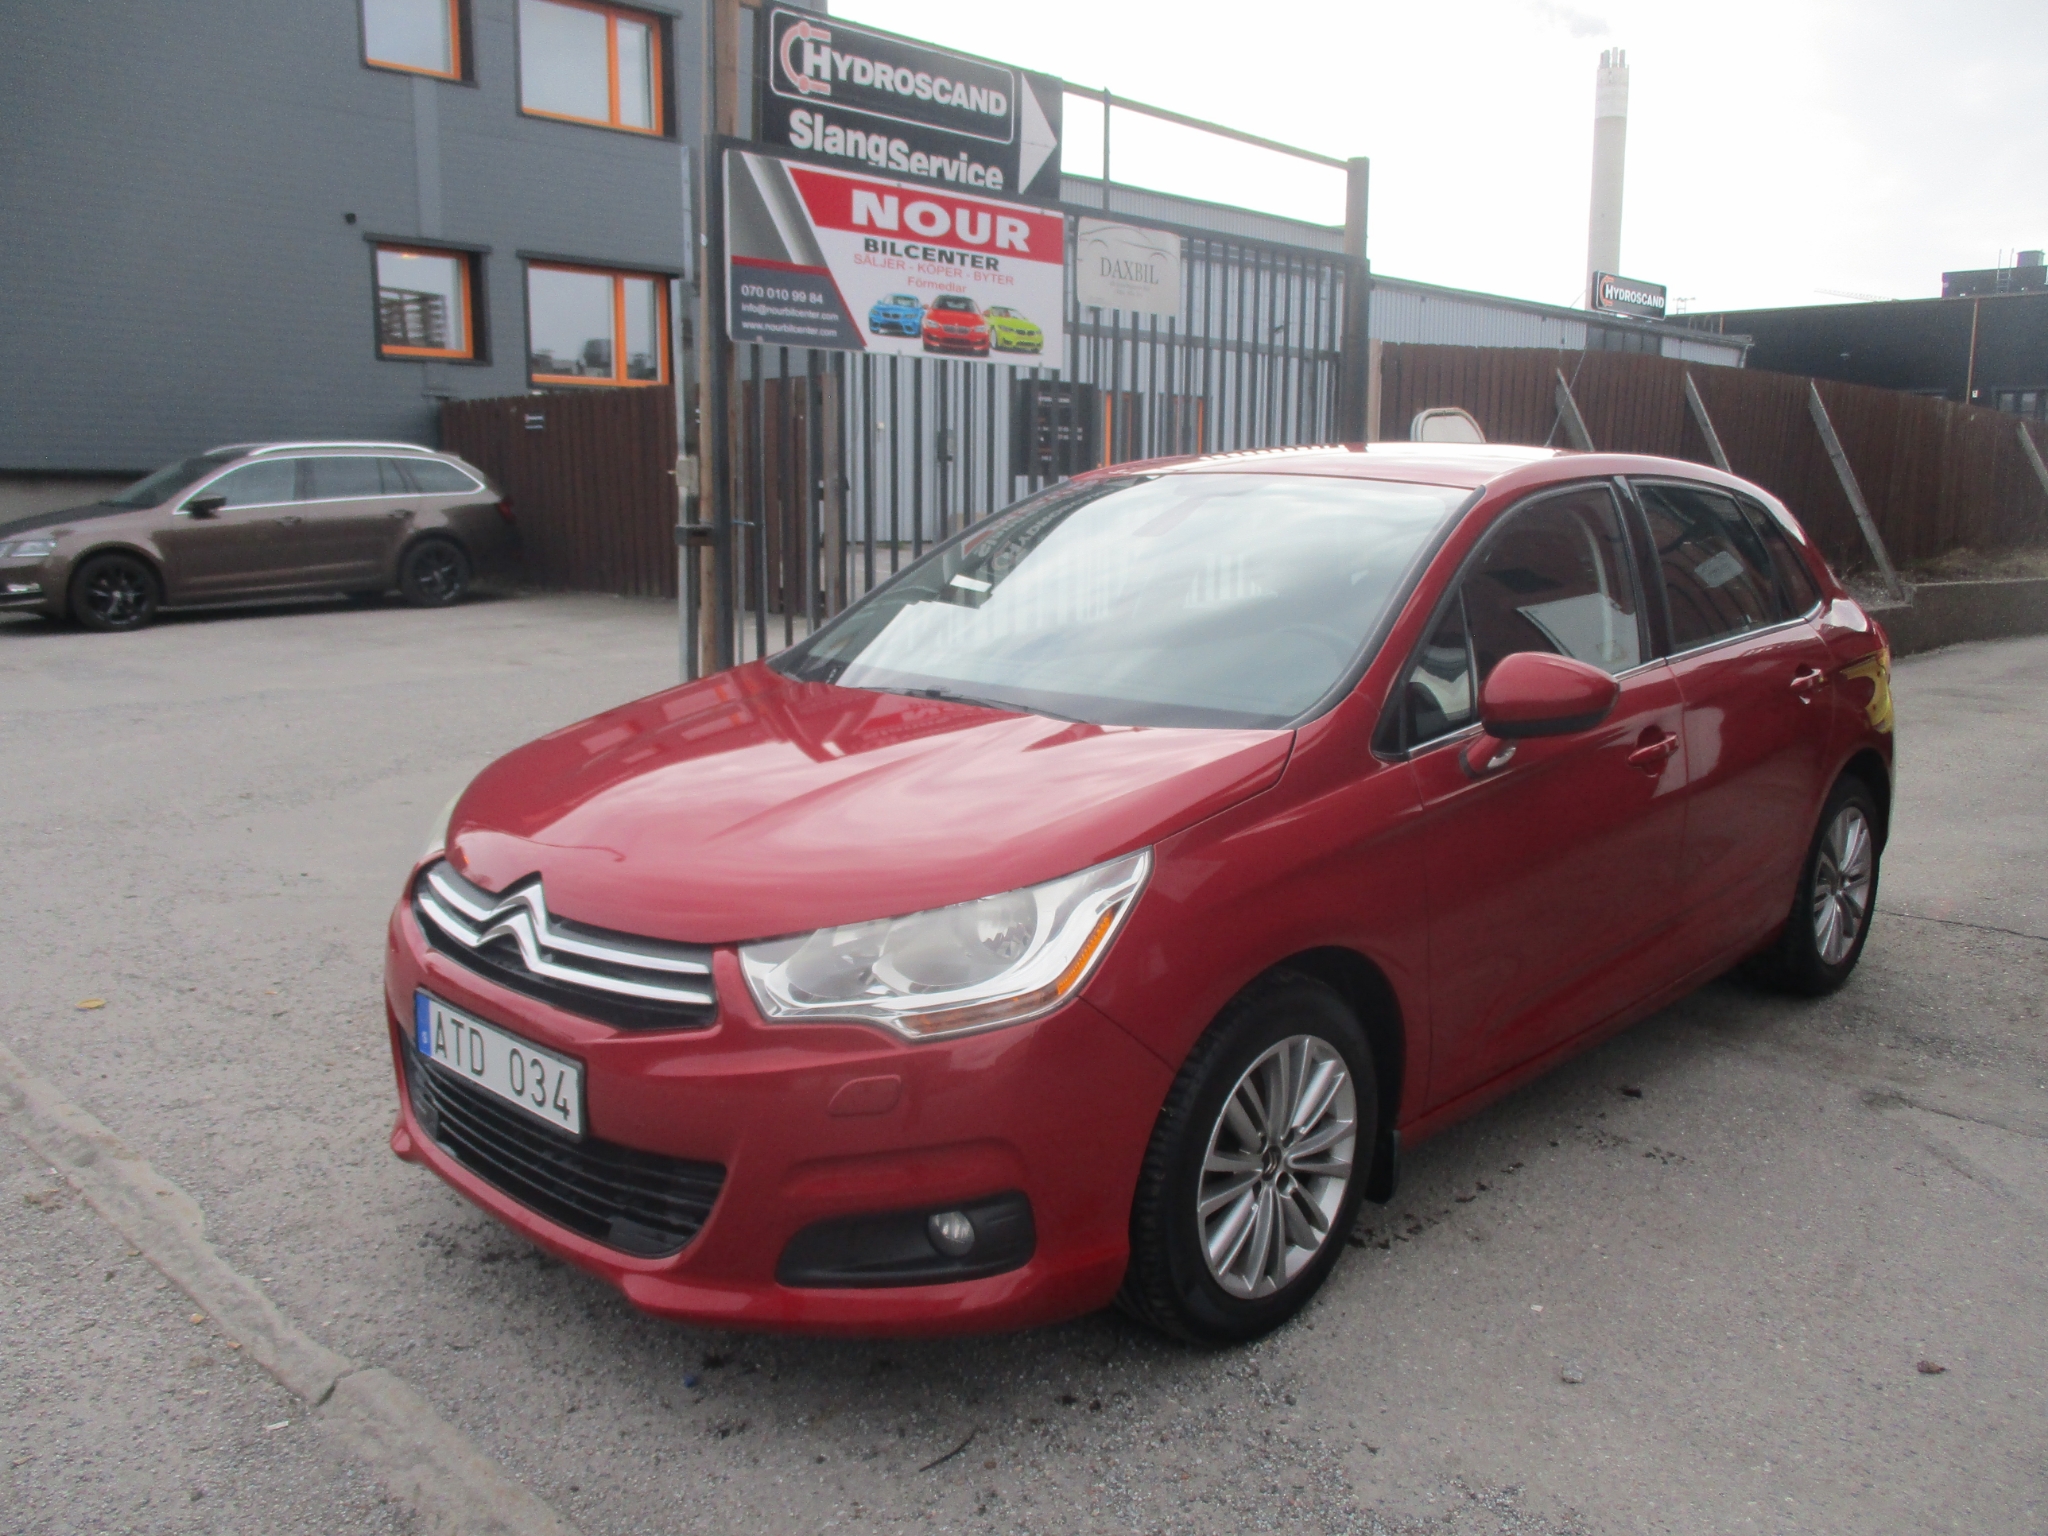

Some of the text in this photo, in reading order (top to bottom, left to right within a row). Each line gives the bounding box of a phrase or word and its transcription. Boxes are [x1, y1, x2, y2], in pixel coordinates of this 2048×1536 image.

[802, 40, 1008, 117] HYDROSCAND
[788, 109, 1004, 191] SlangService
[852, 189, 1030, 252] NOUR
[853, 253, 906, 271] SÄLJER
[917, 261, 963, 279] KÖPER
[974, 269, 1015, 286] BYTER
[864, 236, 1000, 272] BILCENTER
[1100, 256, 1159, 285] DAXBIL
[741, 284, 823, 304] 070 010 99 84
[907, 275, 967, 293] Förmedlar
[1605, 283, 1665, 309] HYDROSCAND
[435, 1010, 571, 1122] ATD 034
